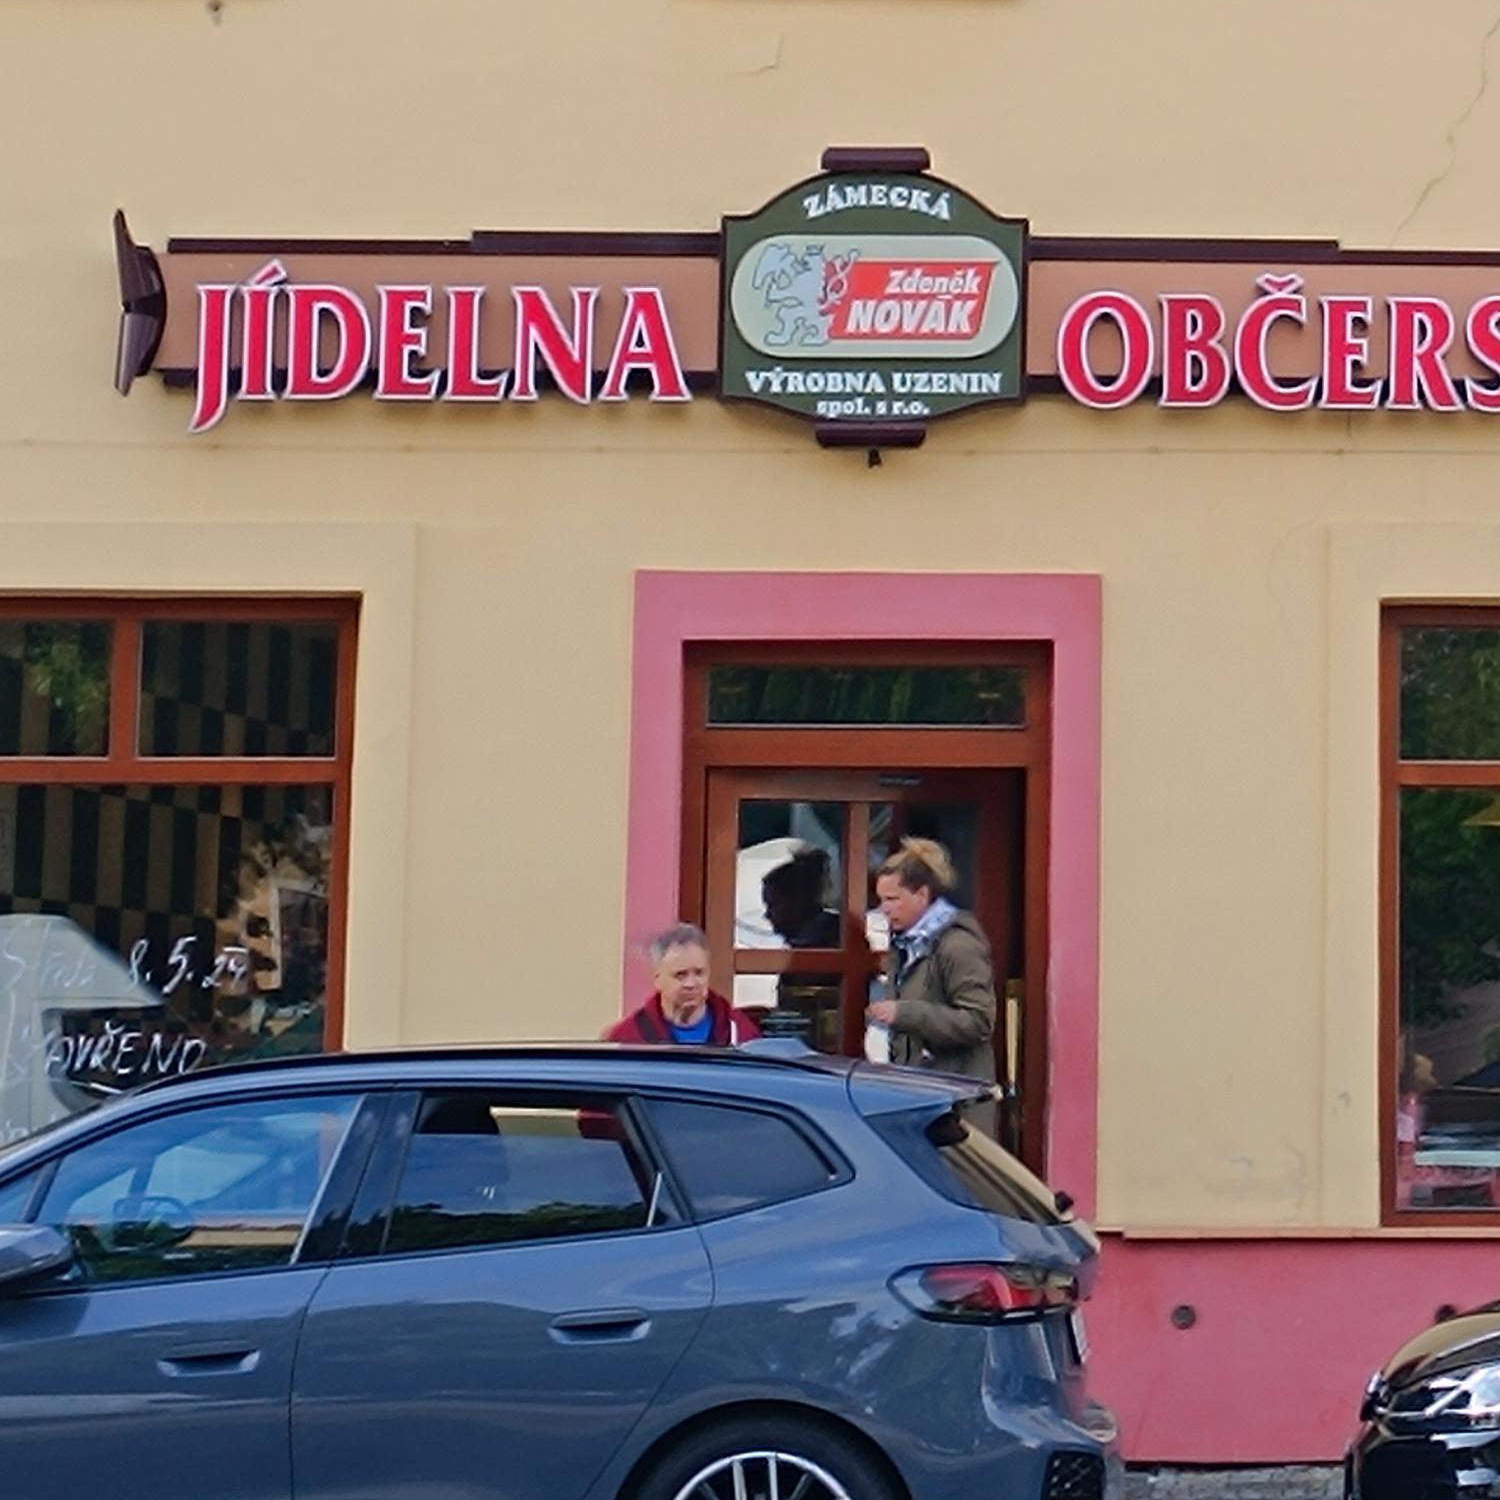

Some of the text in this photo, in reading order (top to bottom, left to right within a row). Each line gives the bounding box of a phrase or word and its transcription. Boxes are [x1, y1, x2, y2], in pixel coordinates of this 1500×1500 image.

[803, 183, 951, 221] ZÁMECKÁ
[884, 268, 982, 297] Zdeněk
[844, 297, 977, 335] NOVÁK
[188, 258, 693, 434] JÍDELNA
[745, 366, 1003, 395] VÝROBNA UZENIN
[816, 399, 930, 419] spol. s r.o.
